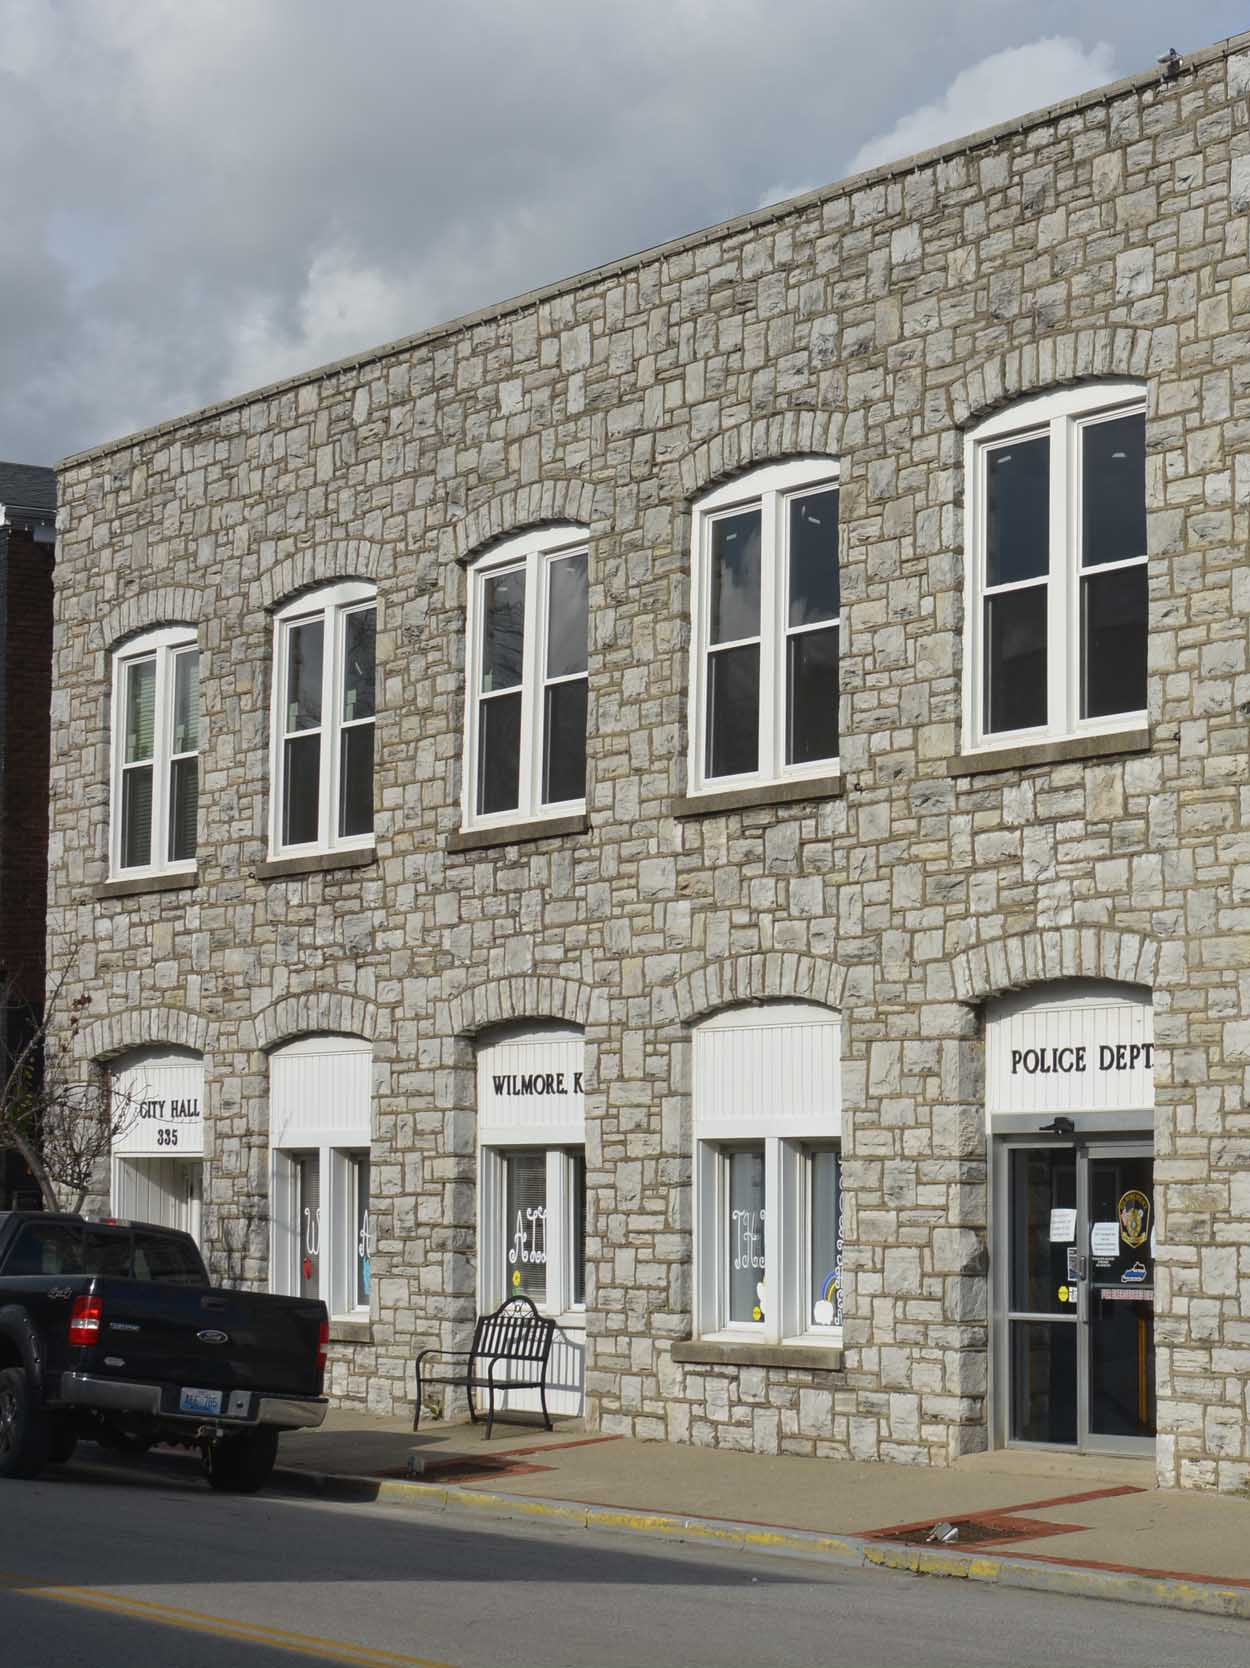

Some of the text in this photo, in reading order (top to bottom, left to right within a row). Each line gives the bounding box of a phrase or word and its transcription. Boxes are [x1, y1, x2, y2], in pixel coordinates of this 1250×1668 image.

[1011, 1046, 1087, 1074] POLICE
[573, 1071, 584, 1094] K
[140, 1098, 200, 1119] CITY HALL
[157, 1128, 179, 1146] 335
